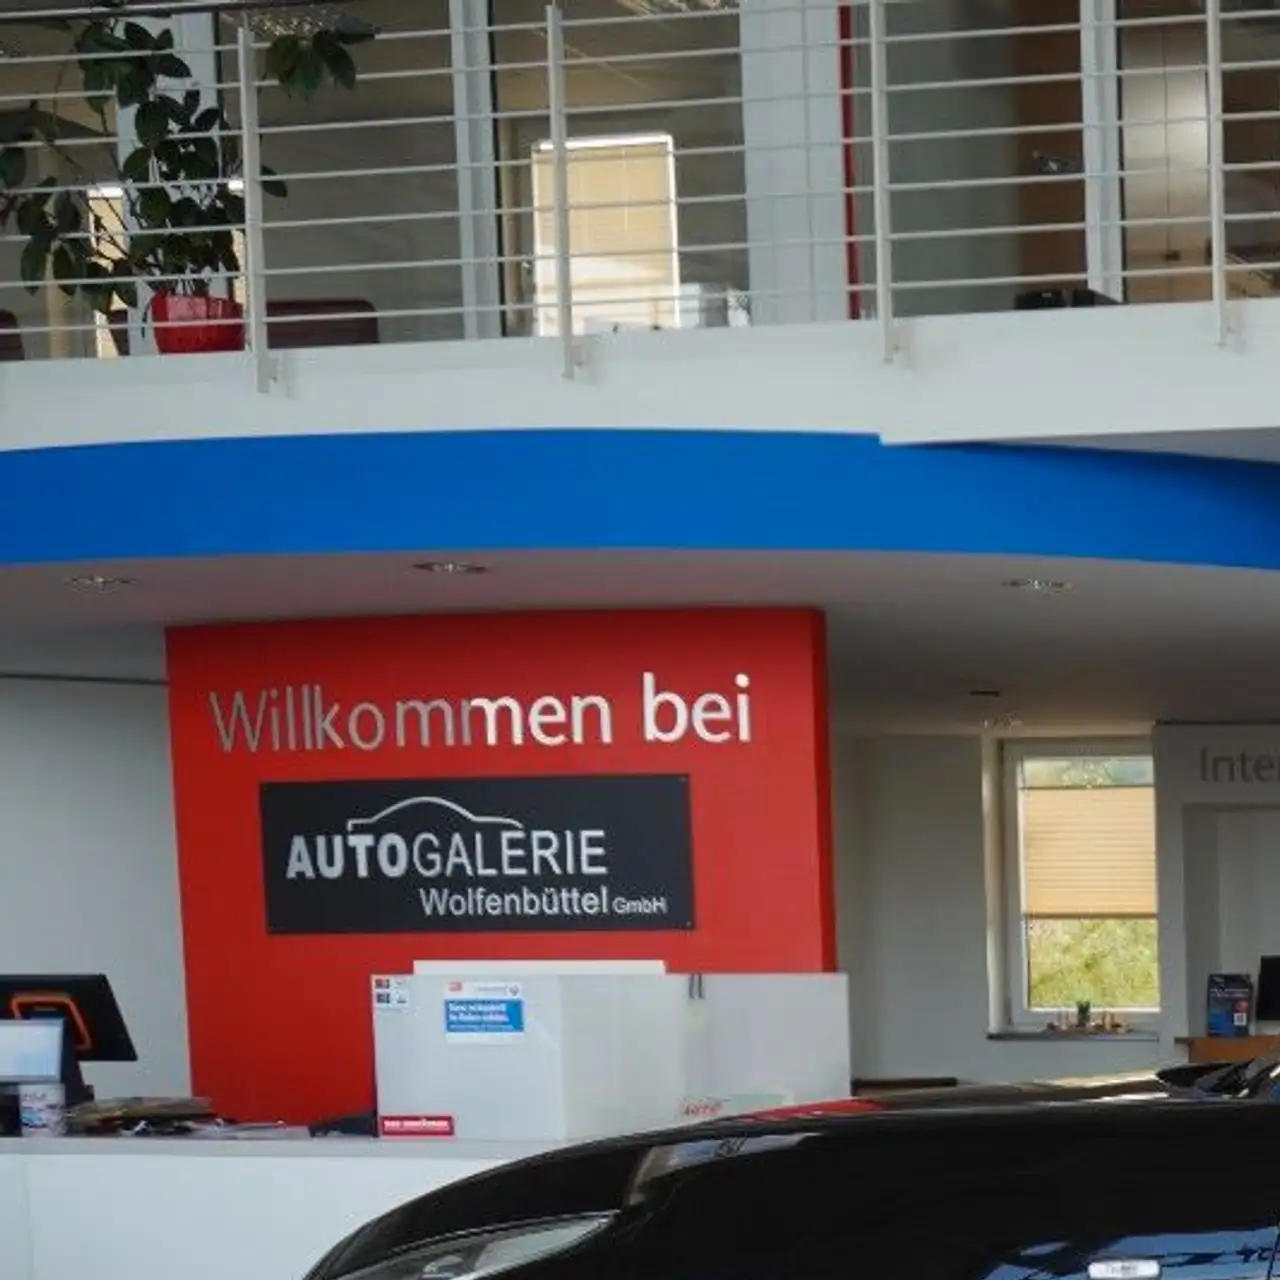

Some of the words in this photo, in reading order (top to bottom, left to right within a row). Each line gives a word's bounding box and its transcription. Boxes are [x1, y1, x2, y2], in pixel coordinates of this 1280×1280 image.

[209, 683, 613, 754] Willkommen
[643, 672, 752, 744] bei
[286, 829, 607, 880] AUTOGALERIE
[419, 886, 609, 919] Wolfenbüttel
[612, 896, 668, 915] GmbH
